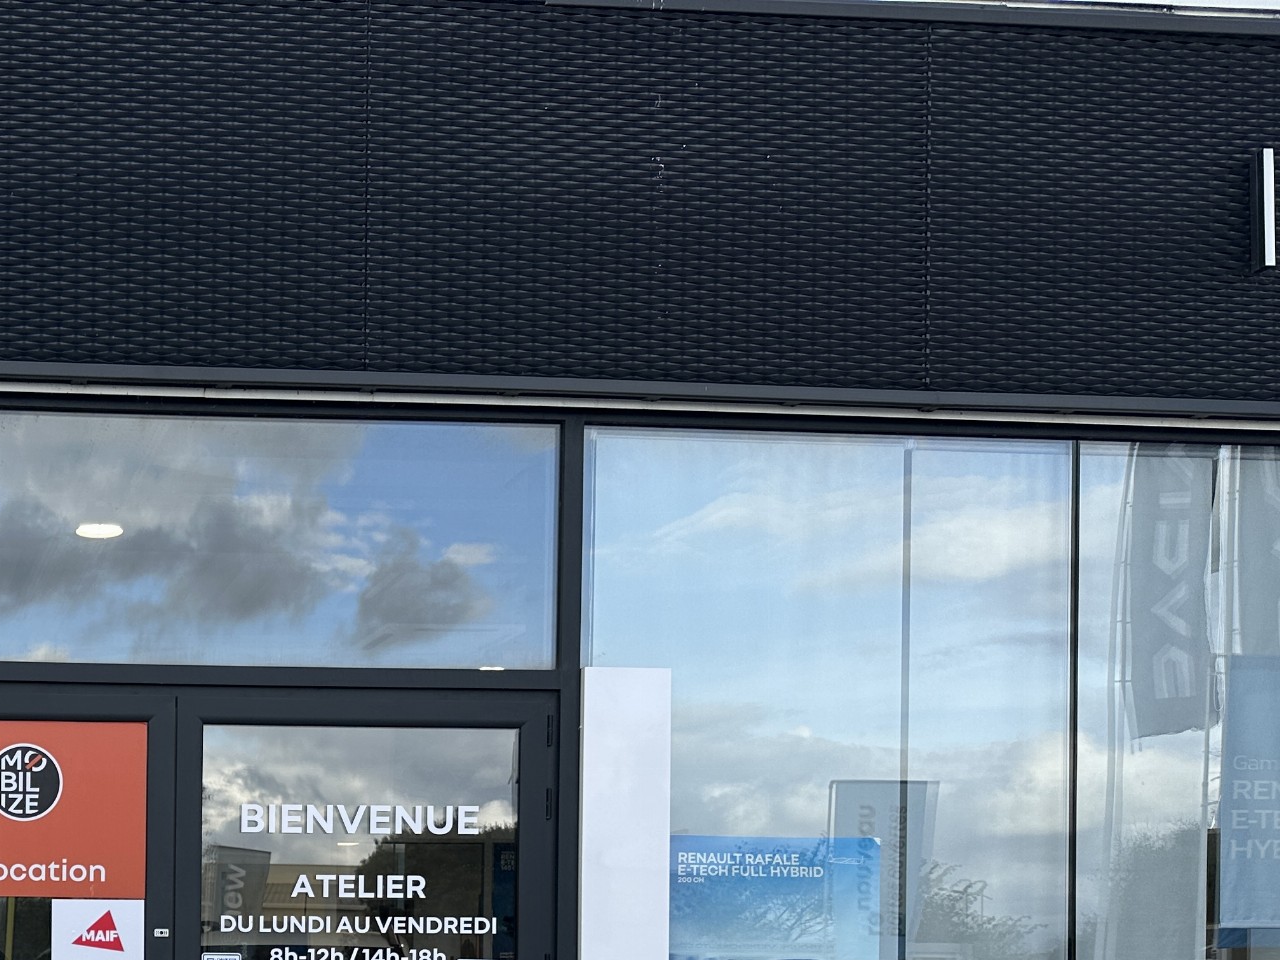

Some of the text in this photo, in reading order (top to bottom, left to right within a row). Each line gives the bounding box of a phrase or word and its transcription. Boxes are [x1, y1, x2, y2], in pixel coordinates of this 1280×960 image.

[240, 804, 480, 835] BIENVENUE
[678, 852, 800, 866] RENAULT RAFALE
[678, 865, 824, 878] E-TECH FULL HYBRID
[290, 874, 427, 899] ATELIER
[221, 916, 497, 935] DU LUNDI AU VENDREDI
[82, 930, 118, 943] MAIF
